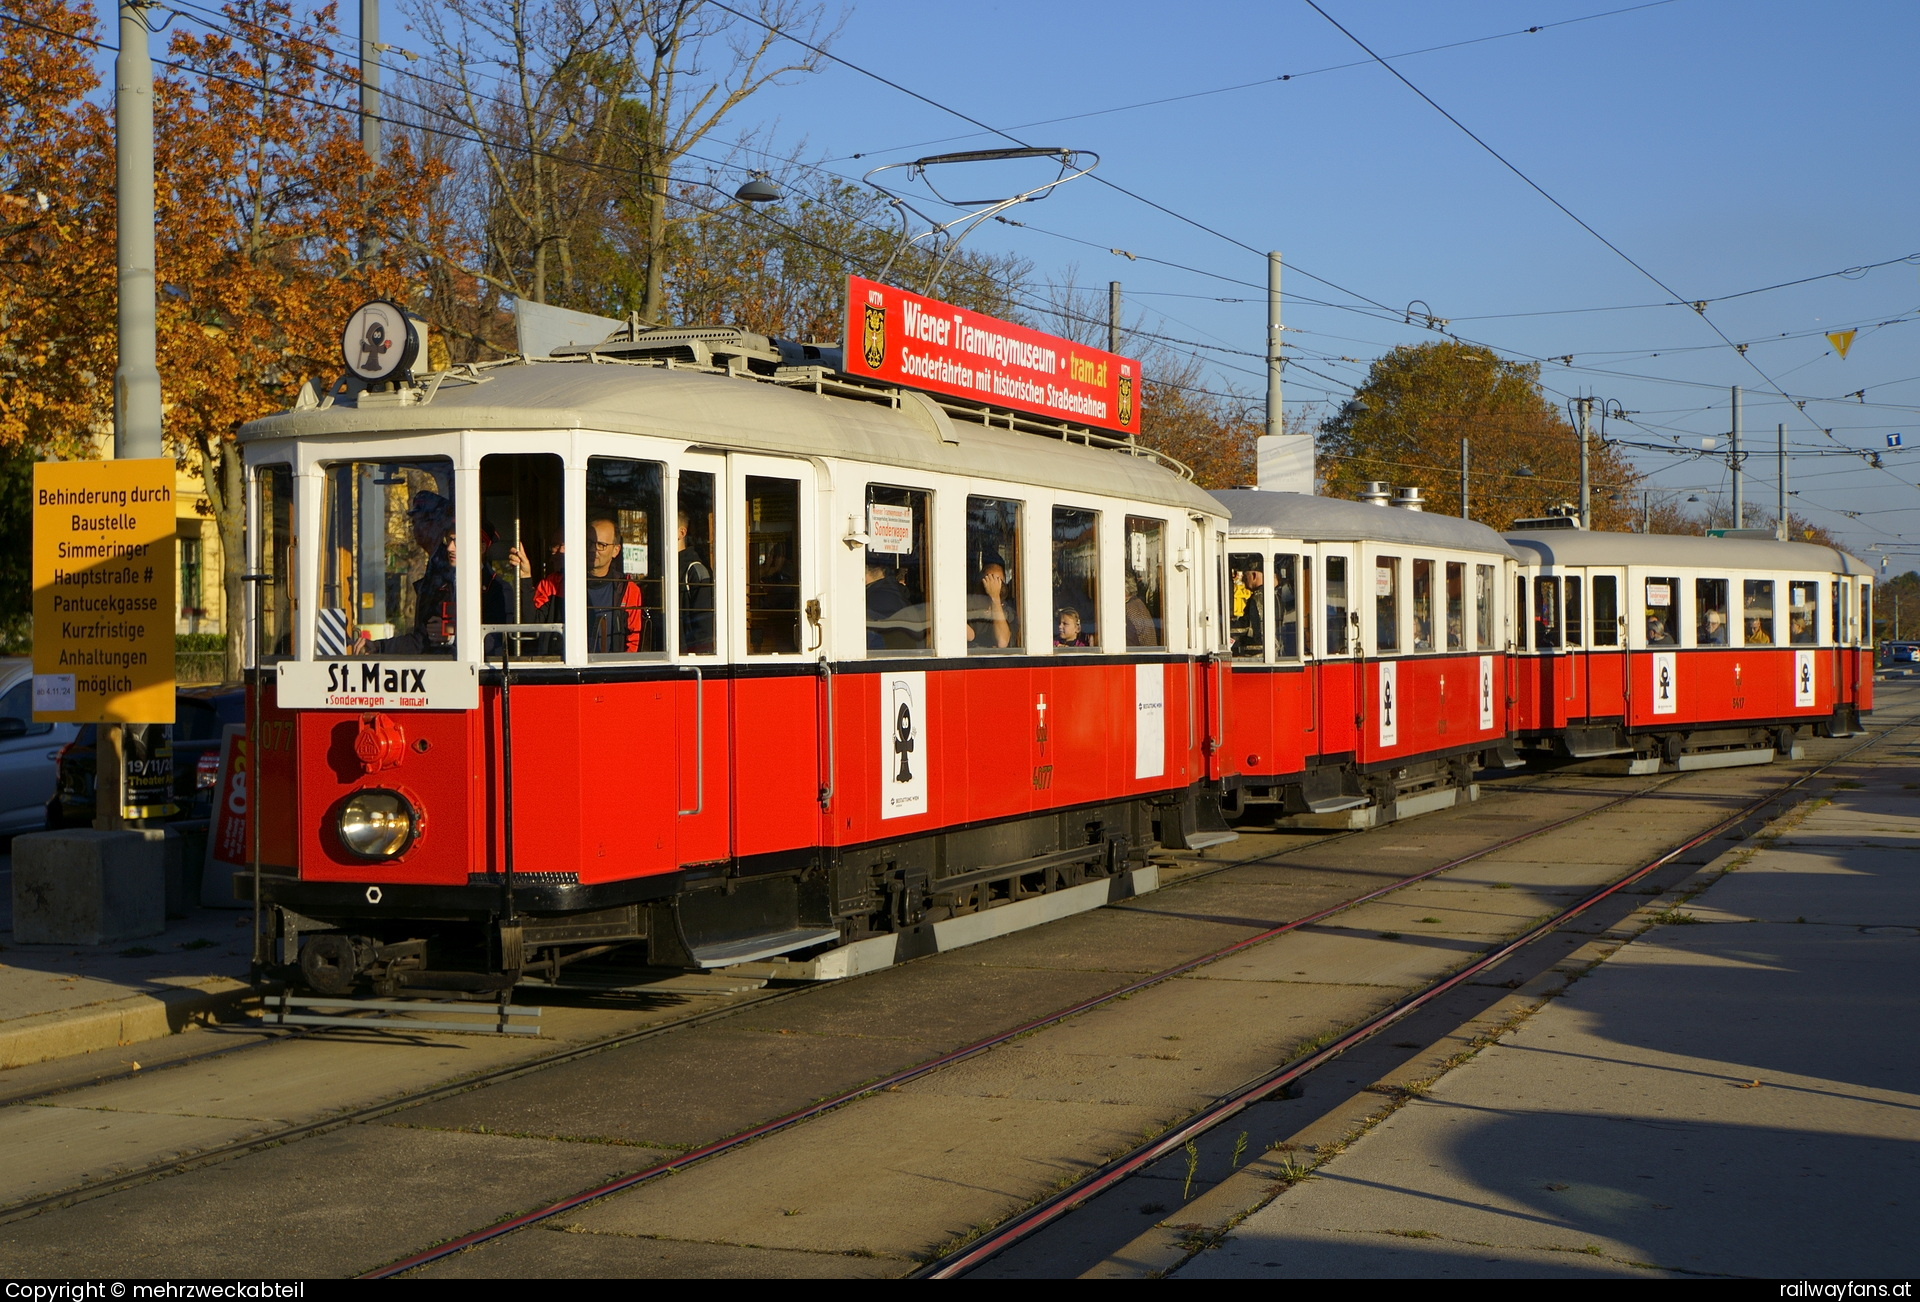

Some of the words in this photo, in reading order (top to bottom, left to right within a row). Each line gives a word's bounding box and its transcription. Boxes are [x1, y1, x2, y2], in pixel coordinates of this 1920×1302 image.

[903, 299, 951, 346] Wiener
[954, 314, 1056, 375] Tramwaymuseum
[1070, 350, 1108, 388] tram.at
[901, 347, 973, 387] Sonderfahrten
[975, 368, 991, 393] mit
[993, 373, 1045, 405] historischen
[1047, 384, 1107, 420] Straßenbahnen
[1888, 434, 1899, 446] T
[39, 489, 127, 507] Behinderung
[131, 486, 170, 503] durch
[71, 515, 137, 532] Baustelle
[875, 521, 909, 541] Sonderwagen
[58, 541, 149, 560] Simmeringer
[54, 567, 140, 588] Hauptstraße
[143, 566, 153, 584] #
[54, 595, 157, 614] Pantucekgasse
[62, 621, 145, 641] Kurzfristige
[59, 650, 147, 669] Anhaltungen
[77, 675, 132, 695] möglich
[327, 663, 356, 692] St.
[361, 663, 426, 692] Marx
[329, 695, 384, 707] Sonderwagen
[399, 697, 425, 707] tram.at
[128, 775, 164, 786] Theater
[1033, 765, 1053, 790] 4077
